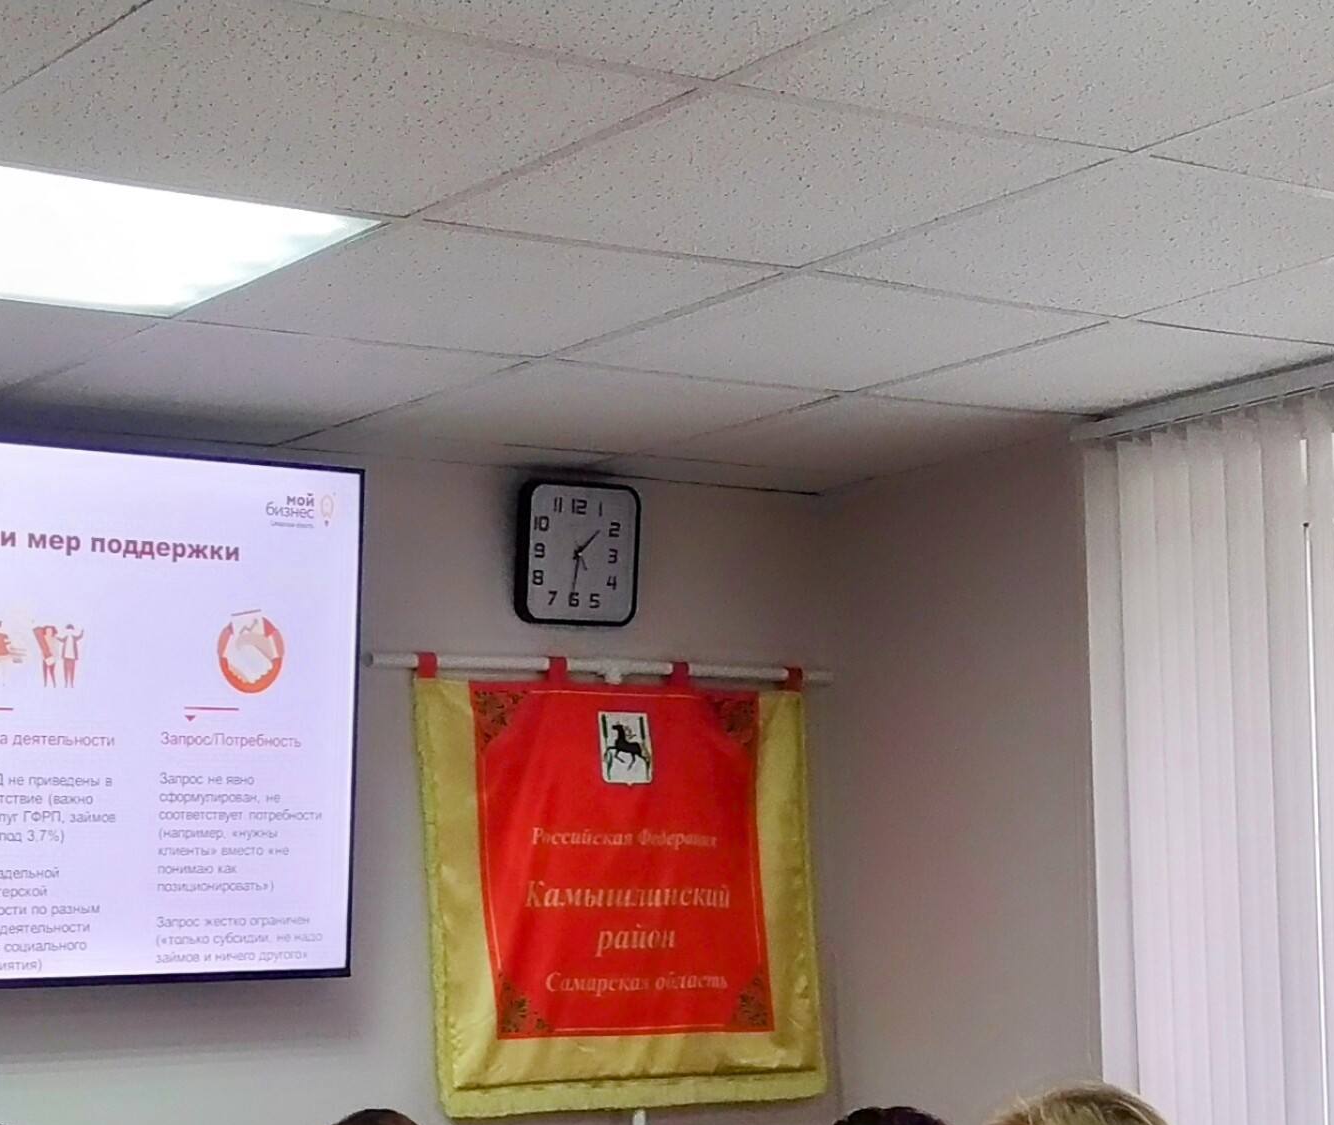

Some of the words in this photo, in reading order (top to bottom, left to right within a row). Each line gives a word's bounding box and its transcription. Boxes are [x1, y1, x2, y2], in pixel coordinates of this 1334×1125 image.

[287, 493, 314, 506] мой
[554, 497, 563, 513] 11
[572, 499, 587, 515] 12
[266, 501, 314, 519] бизнес
[599, 502, 603, 517] 1
[534, 516, 549, 531] 10
[609, 522, 621, 538] 2
[28, 532, 81, 556] мер
[90, 535, 241, 563] поддержки
[534, 543, 545, 558] 9
[608, 549, 618, 564] 3
[532, 570, 544, 585] 8
[606, 576, 617, 590] 4
[547, 591, 558, 605] 7
[569, 592, 579, 607] 6
[589, 594, 600, 608] 5
[13, 734, 115, 748] деятельности
[160, 732, 302, 750] Запрос/Потребность
[8, 775, 25, 786] не
[28, 776, 100, 790] приведены
[159, 773, 204, 788] Запрос
[208, 775, 222, 785] не
[227, 775, 255, 785] явно
[48, 793, 93, 807] (важно
[159, 792, 260, 806] сформулирован,
[266, 794, 281, 803] не
[69, 811, 116, 823] займов
[159, 810, 243, 823] соответствует
[249, 809, 322, 823] потребности
[0, 831, 22, 844] под
[531, 827, 633, 850] Российская
[222, 846, 264, 856] вместо
[157, 864, 213, 875] понимаю
[218, 864, 237, 874] как
[525, 879, 730, 910] Камышлинский
[32, 906, 47, 916] по
[51, 905, 100, 918] разным
[0, 923, 90, 936] деятельности
[156, 916, 200, 930] Запрос
[4, 940, 87, 954] социального
[595, 923, 676, 957] район
[545, 971, 649, 997] Самарская
[655, 971, 728, 993] область
